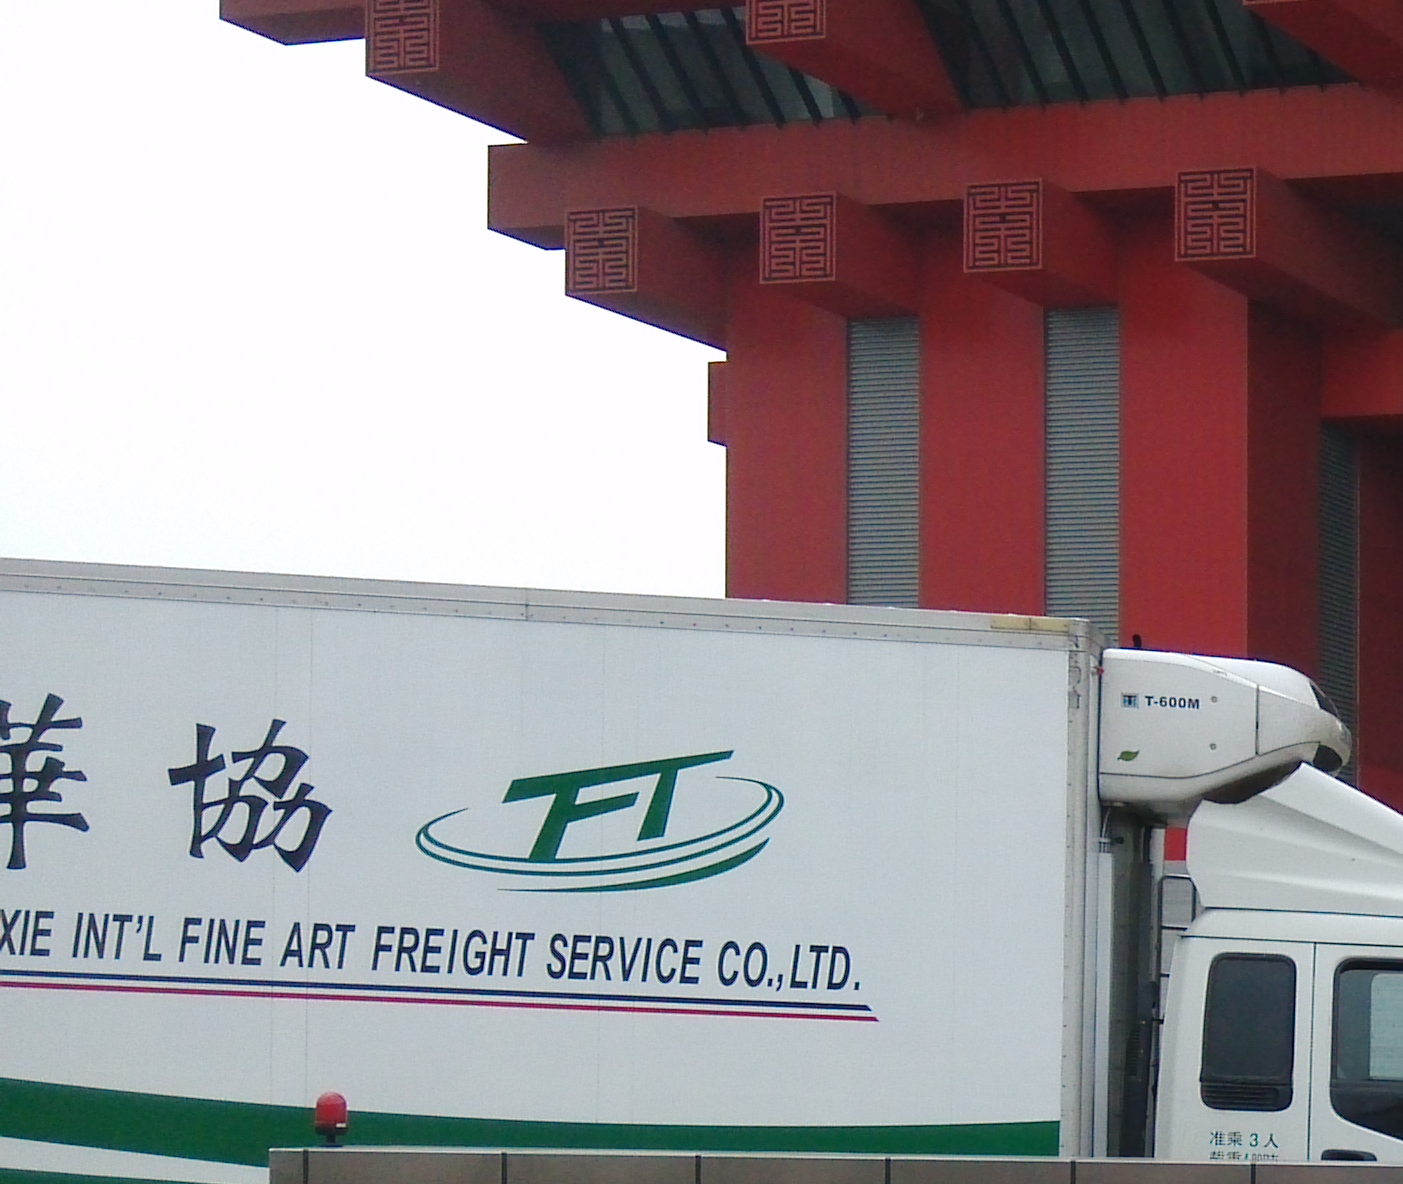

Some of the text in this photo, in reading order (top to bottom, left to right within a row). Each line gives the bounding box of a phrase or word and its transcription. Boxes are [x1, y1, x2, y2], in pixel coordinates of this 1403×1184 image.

[1145, 695, 1200, 710] T-600M
[71, 911, 163, 962] INT'L
[178, 916, 266, 966] FINE
[279, 921, 356, 970] ART
[370, 925, 536, 978] FREIGHT
[546, 932, 704, 985] SERVICE
